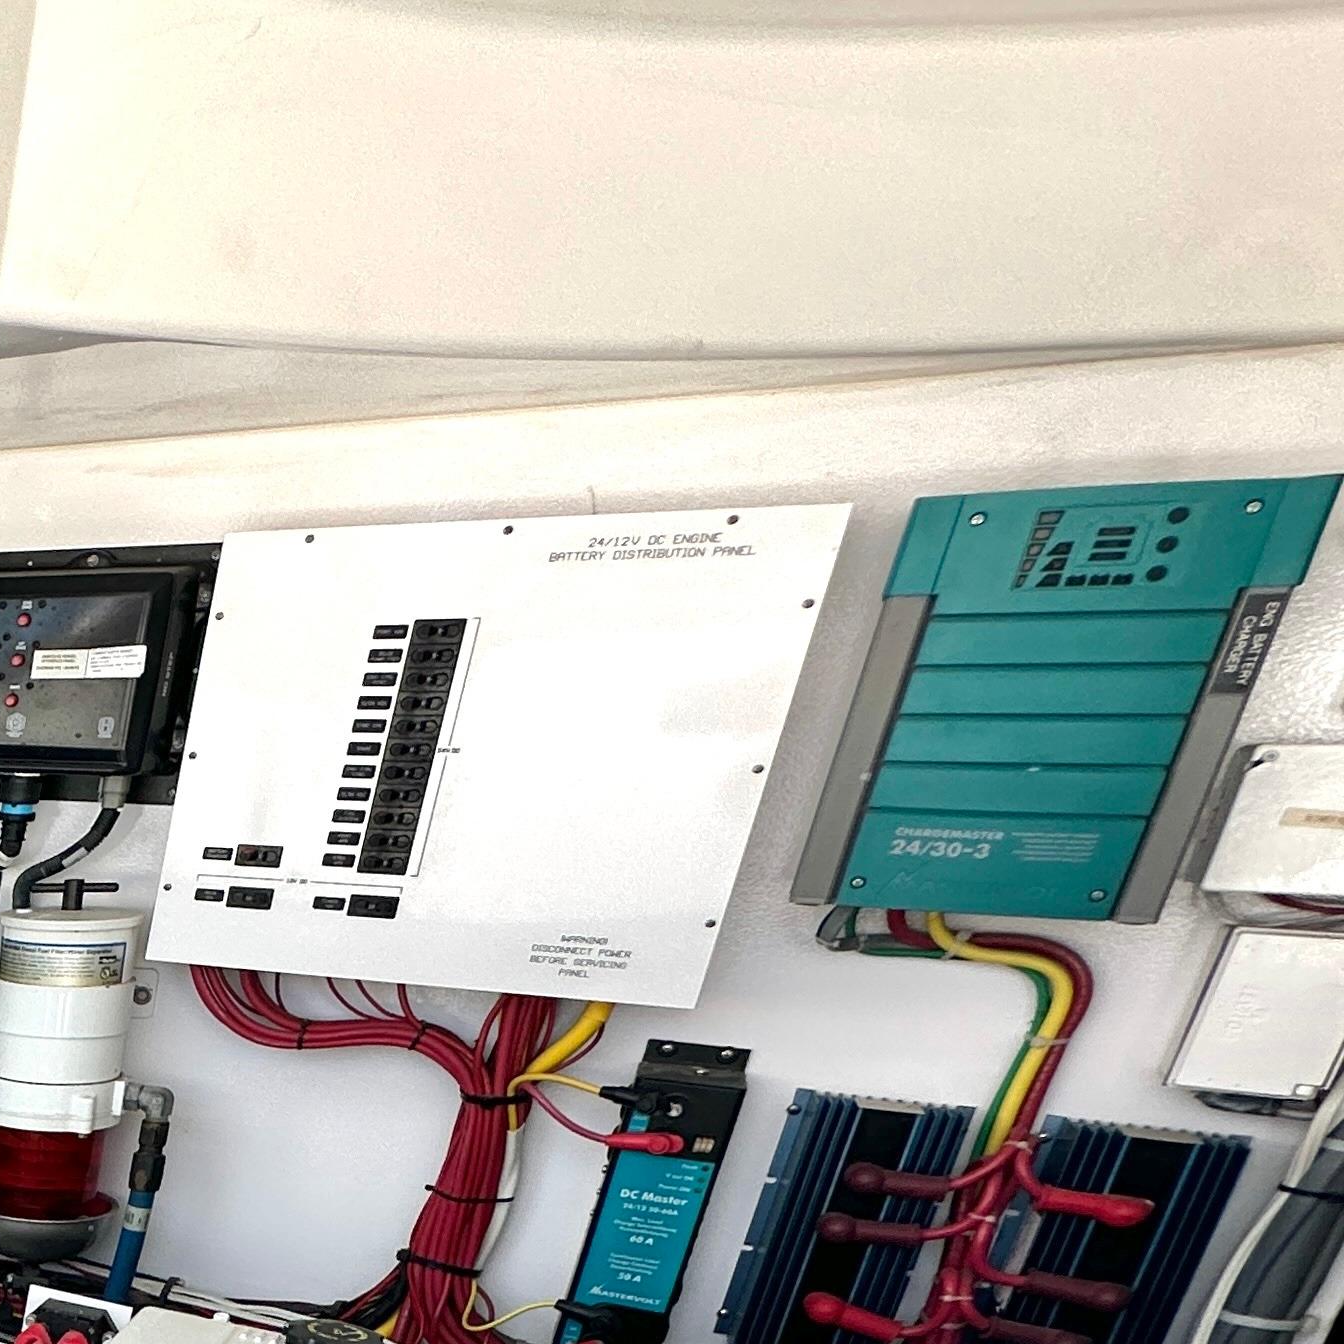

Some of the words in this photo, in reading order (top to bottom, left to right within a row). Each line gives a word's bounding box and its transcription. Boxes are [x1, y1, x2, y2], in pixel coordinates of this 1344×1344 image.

[647, 534, 666, 546] DC
[672, 532, 723, 545] ENGINE
[548, 550, 606, 562] BATTERY
[612, 547, 706, 560] DISTRIBUTION
[711, 545, 756, 556] PANEL
[1258, 601, 1282, 627] ENG
[1222, 615, 1259, 674] CHARGER
[1235, 632, 1269, 686] BATTERY
[888, 839, 992, 859] 24/30-3
[619, 1188, 640, 1200] DC
[641, 1191, 689, 1206] Master
[644, 1237, 654, 1246] A
[631, 1274, 642, 1283] A
